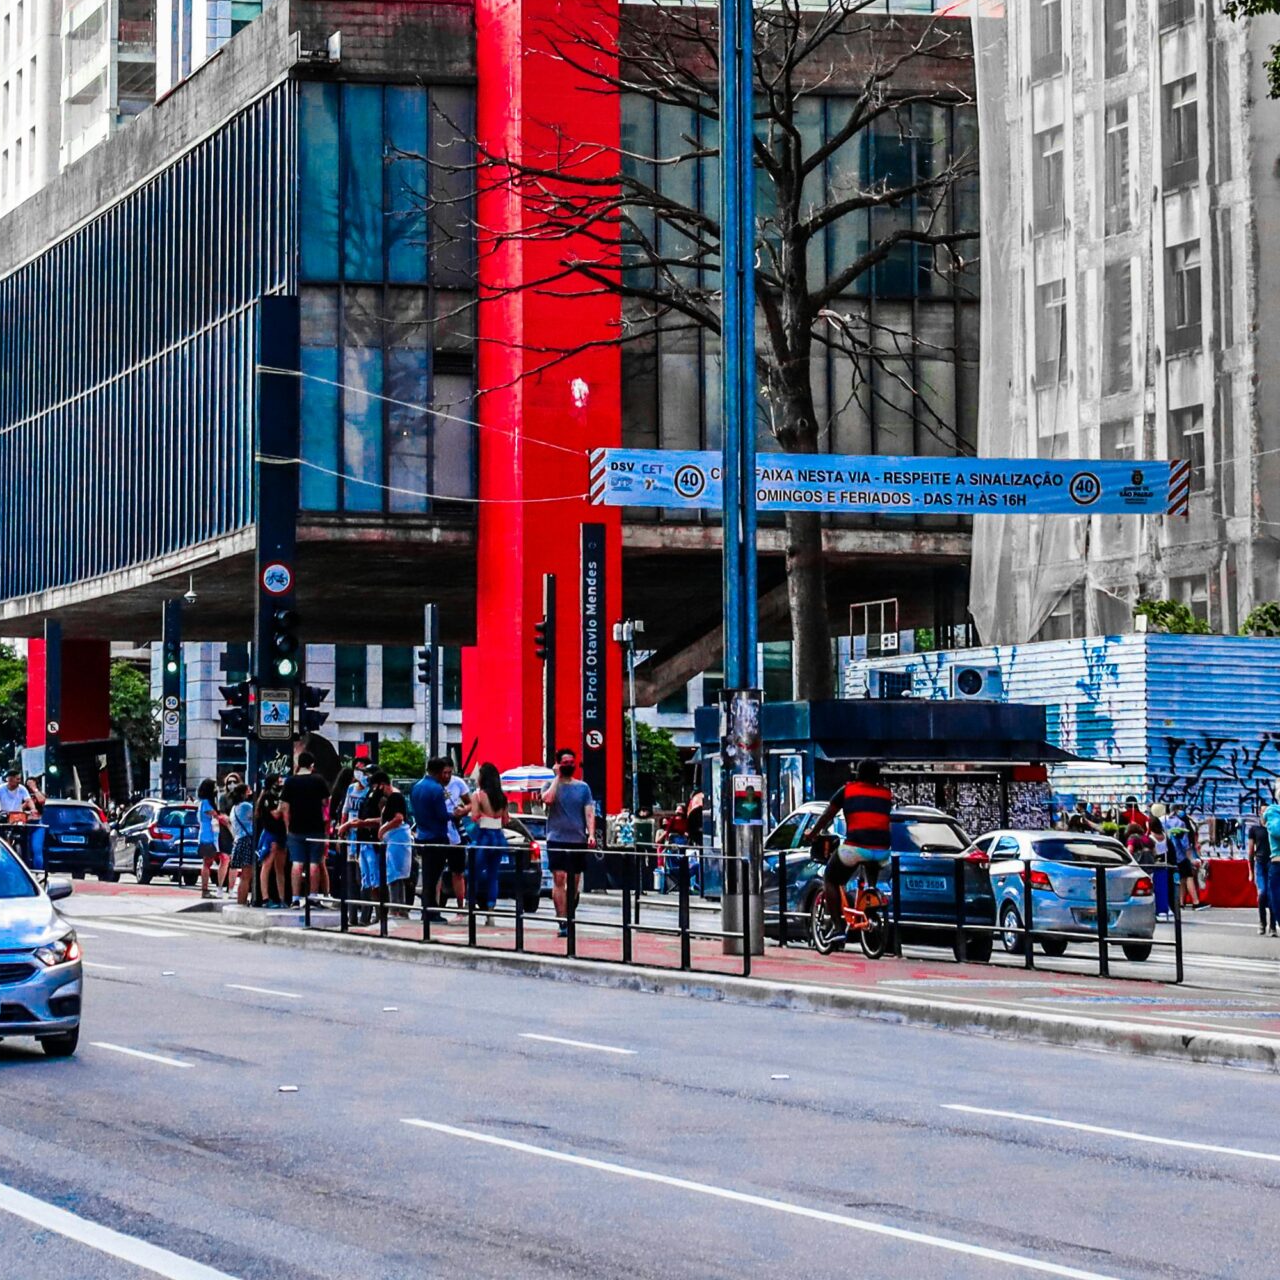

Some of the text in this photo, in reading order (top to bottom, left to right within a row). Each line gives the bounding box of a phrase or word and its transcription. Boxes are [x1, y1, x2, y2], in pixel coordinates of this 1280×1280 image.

[610, 462, 663, 475] DSV CET
[681, 472, 700, 487] 40
[798, 469, 844, 483] NESTA
[848, 471, 870, 484] VIA
[883, 472, 950, 486] RESPEITE
[955, 474, 966, 486] A
[971, 471, 1064, 488] SINALIZAÇÃO
[1075, 479, 1094, 493] 40
[756, 489, 823, 503] OMINGOS
[827, 491, 836, 503] E
[840, 491, 911, 505] FERIADOS
[923, 493, 953, 505] DAS
[956, 493, 976, 505] 7H
[978, 490, 997, 506] ÀS
[1003, 493, 1027, 506] 16H
[586, 561, 597, 719] R. Prof. Otavio Mendes
